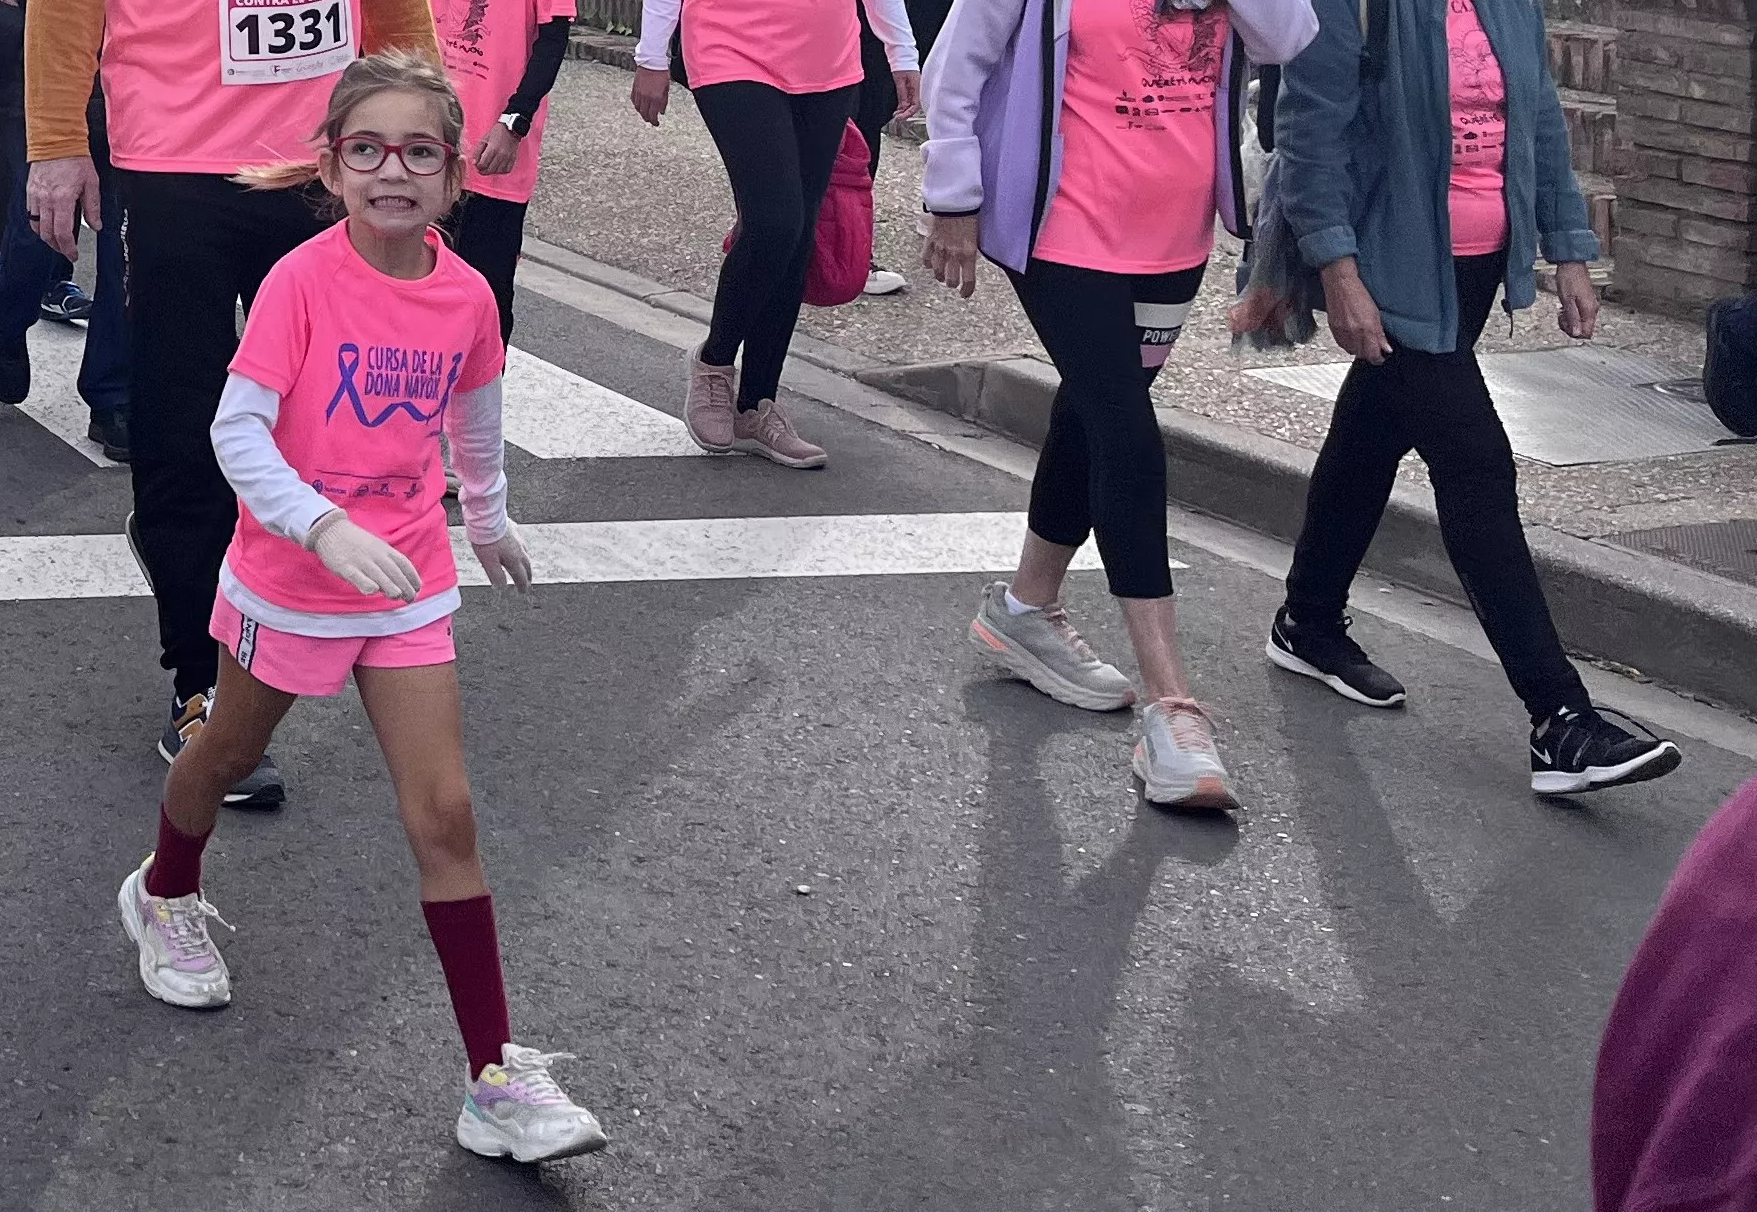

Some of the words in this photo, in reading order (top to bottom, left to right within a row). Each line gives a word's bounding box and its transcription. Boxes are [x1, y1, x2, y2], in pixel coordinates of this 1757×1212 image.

[235, 2, 342, 55] 1331
[367, 345, 409, 374] CURSA
[411, 349, 427, 375] DE
[429, 351, 443, 376] LA
[364, 371, 402, 397] DONA
